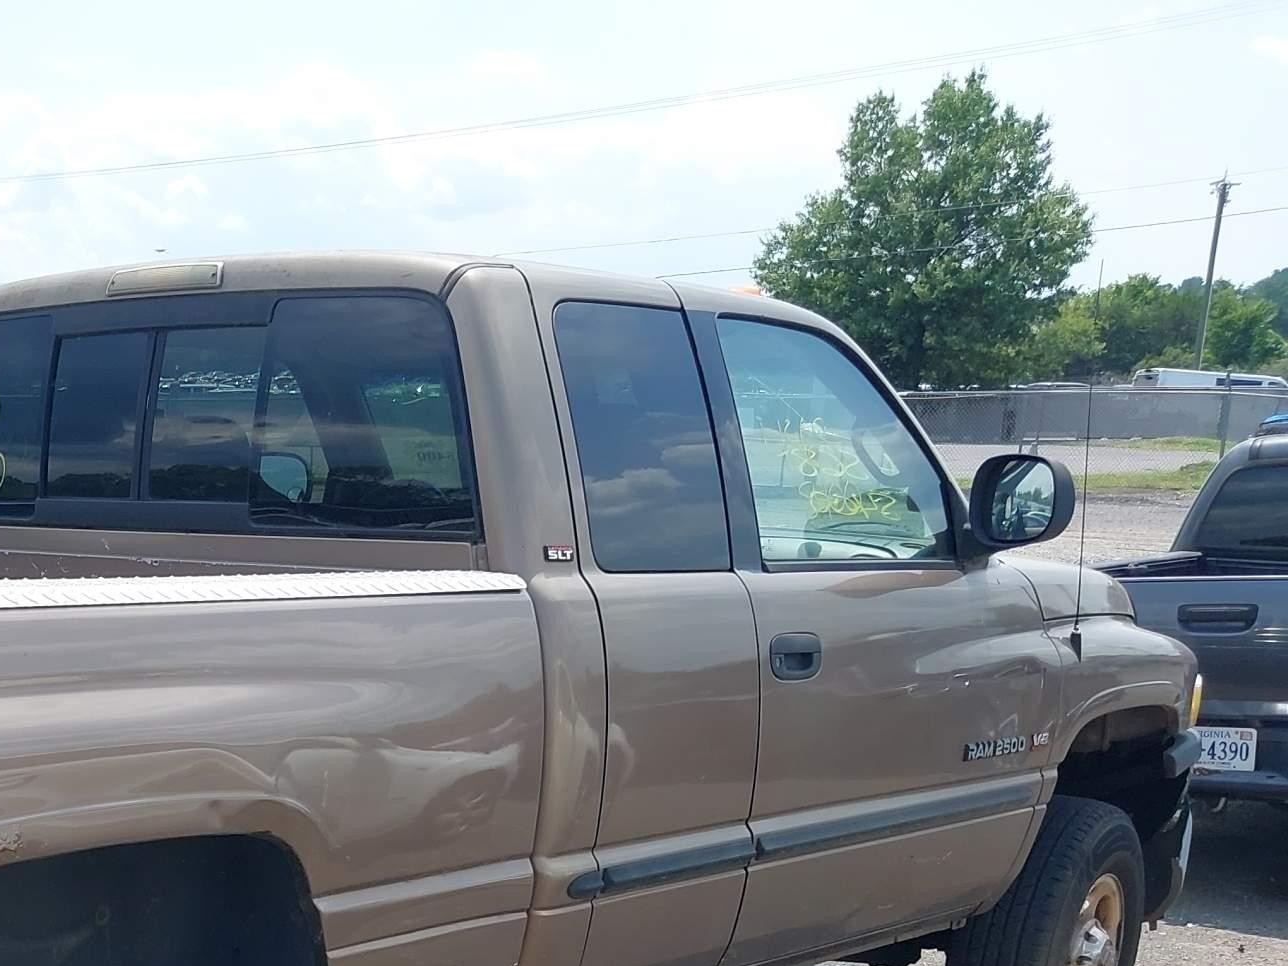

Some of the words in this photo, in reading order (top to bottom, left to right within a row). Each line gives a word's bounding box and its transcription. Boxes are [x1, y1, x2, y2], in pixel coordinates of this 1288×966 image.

[548, 550, 573, 560] SLT
[967, 741, 994, 760] RAM
[996, 736, 1026, 756] 2500
